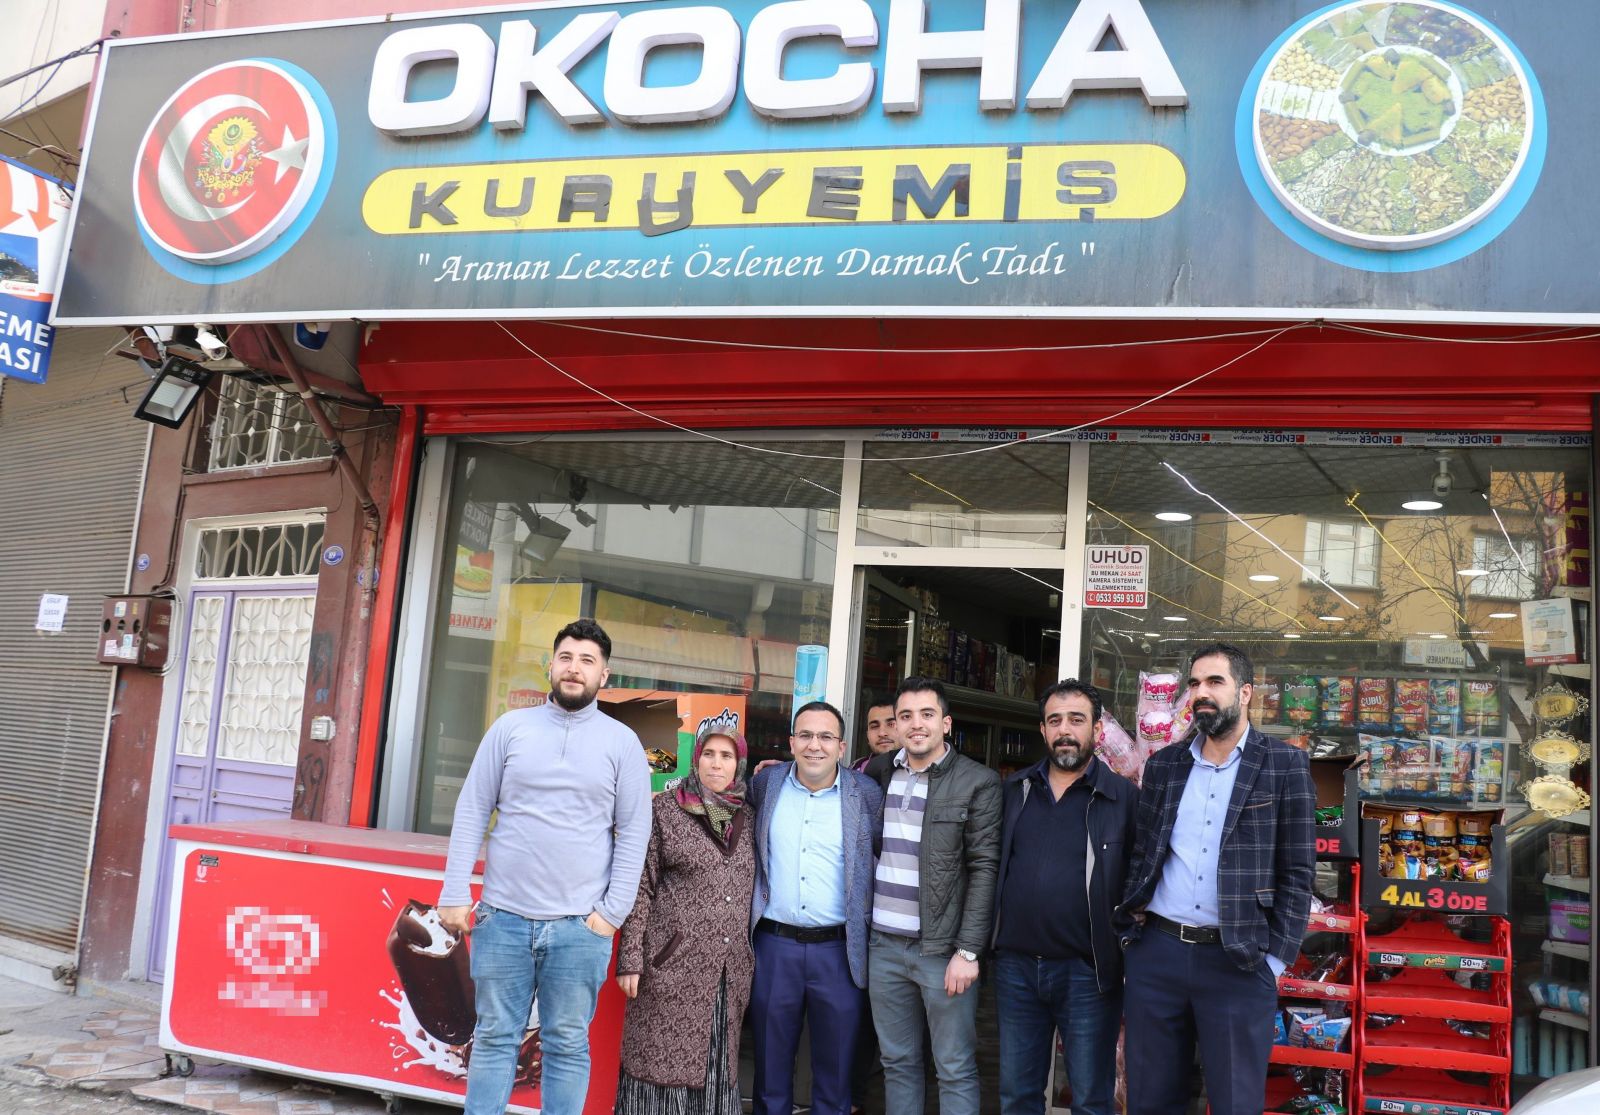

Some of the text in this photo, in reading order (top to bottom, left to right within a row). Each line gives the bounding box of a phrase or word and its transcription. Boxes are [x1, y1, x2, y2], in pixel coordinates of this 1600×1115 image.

[367, 0, 1189, 137] OKOCHA
[408, 145, 1118, 237] KURUYEMİŞ
[434, 253, 550, 282] Aranan
[555, 251, 673, 280] Lezzet
[684, 243, 825, 279] Özlenen
[836, 242, 980, 285] Damak
[982, 241, 1067, 276] Tadı
[1091, 550, 1143, 563] UHUD
[1095, 593, 1144, 604] 0533 959 93 03
[510, 693, 545, 707] Lipton
[1315, 838, 1340, 853] DE
[1380, 884, 1488, 911] 4 AL 3 ÖDE
[1461, 959, 1472, 967] 50
[1383, 1102, 1393, 1110] 50
